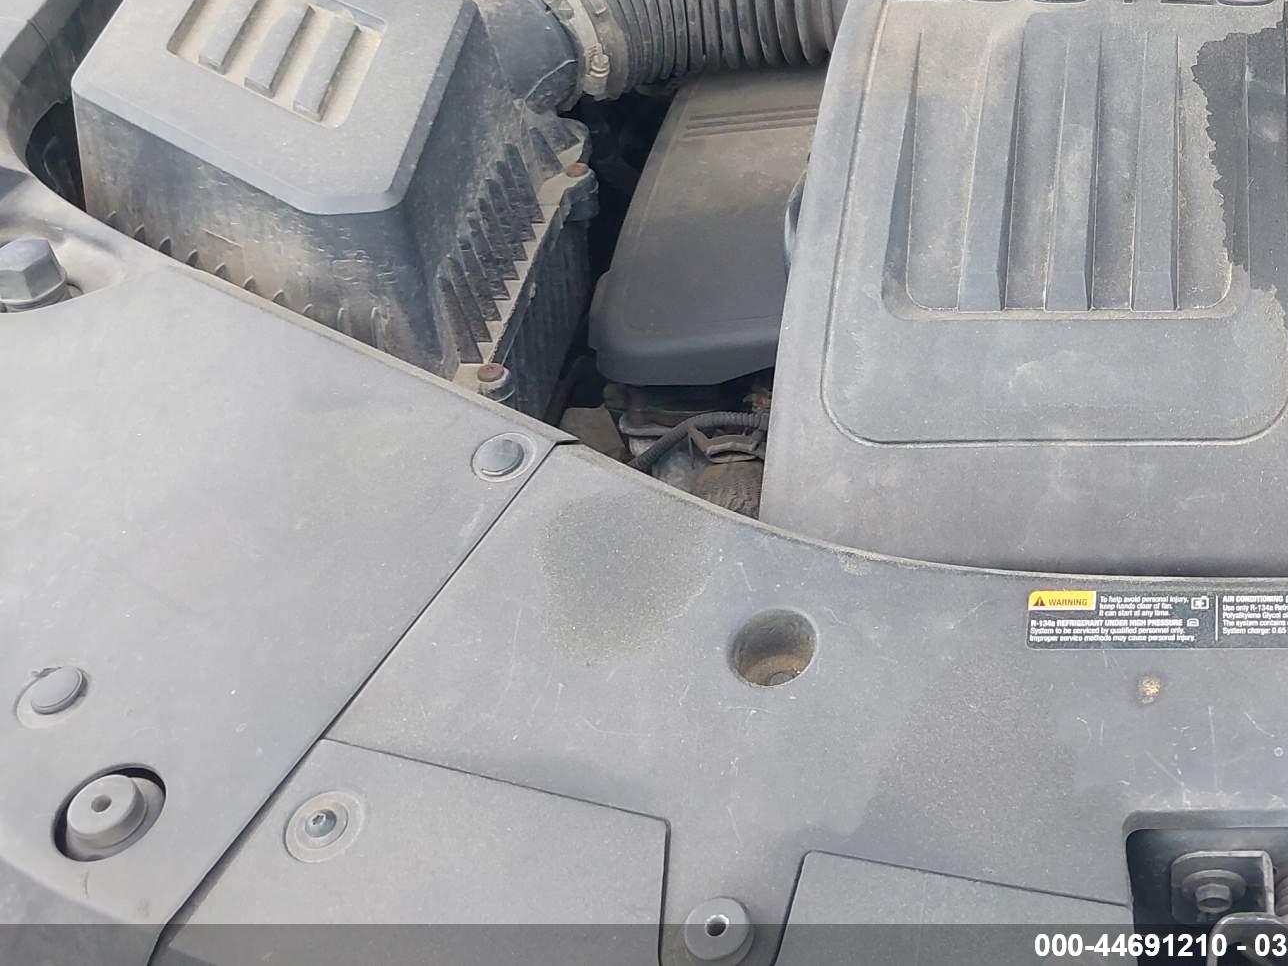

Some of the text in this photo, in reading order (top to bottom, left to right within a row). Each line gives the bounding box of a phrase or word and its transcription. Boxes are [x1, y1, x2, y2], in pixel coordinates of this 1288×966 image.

[1048, 598, 1088, 607] WARNING
[1222, 595, 1283, 603] AIR CONDITIONING
[1223, 627, 1246, 635] System
